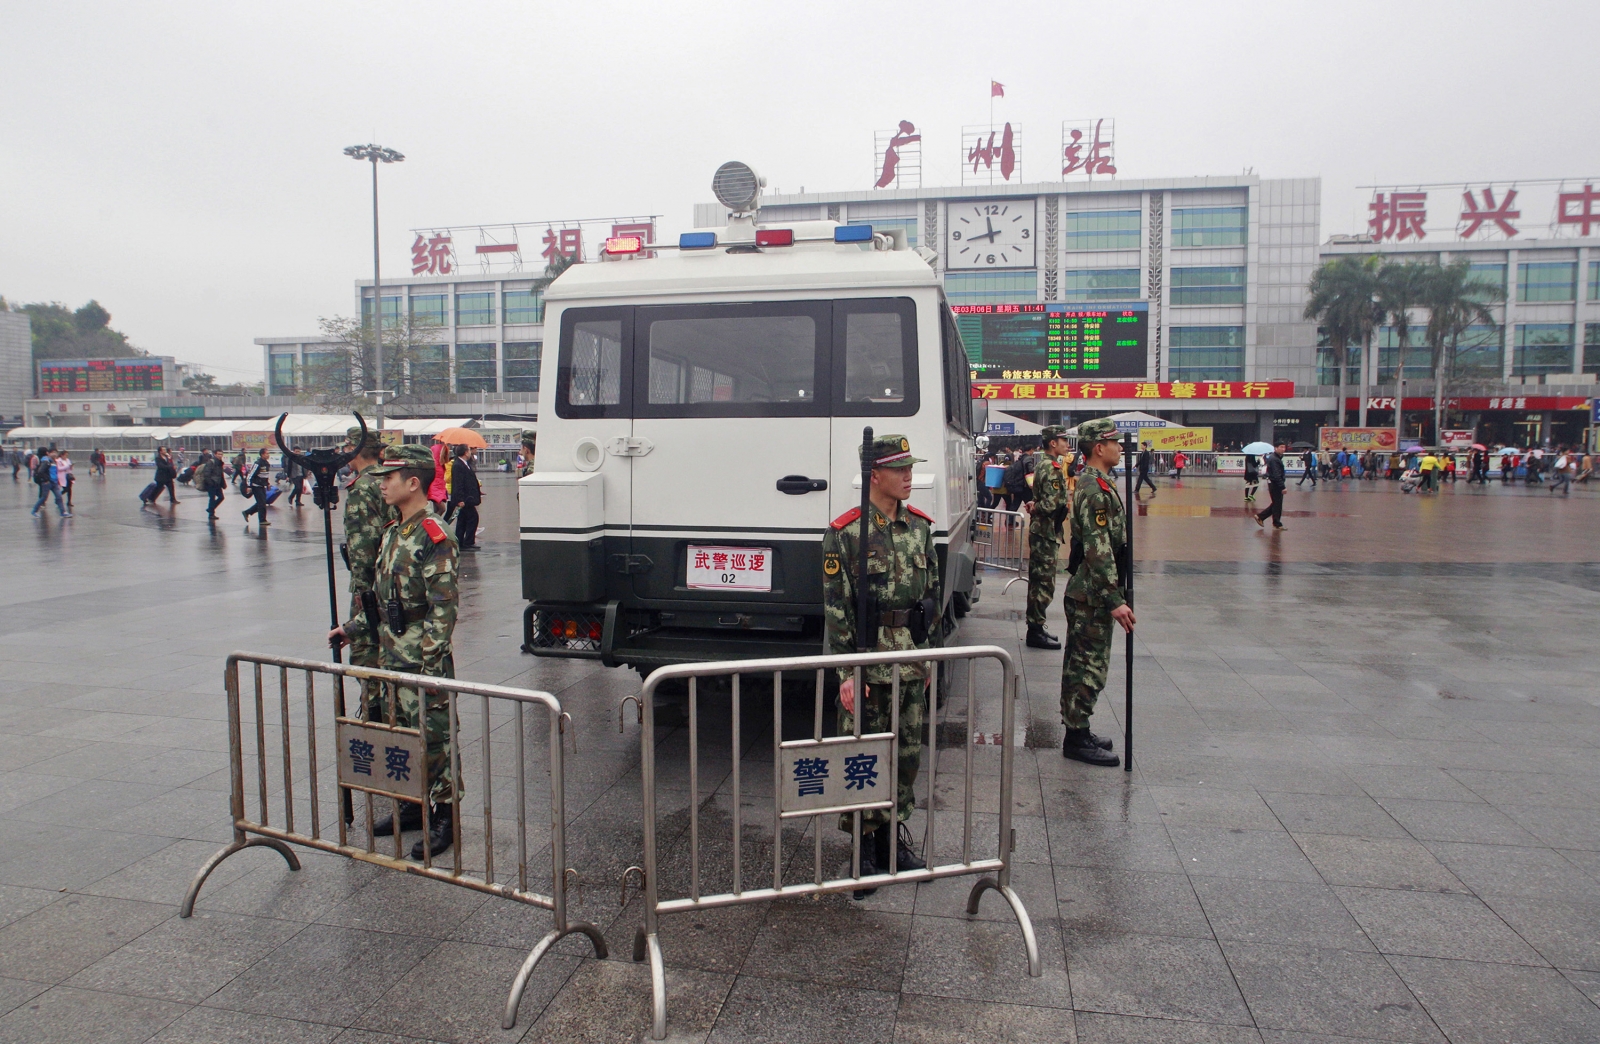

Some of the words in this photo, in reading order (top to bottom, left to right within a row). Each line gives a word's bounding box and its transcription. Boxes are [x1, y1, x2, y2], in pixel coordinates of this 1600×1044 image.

[873, 119, 1116, 188] 广州站
[984, 205, 998, 215] 12
[1368, 184, 1600, 242] 振兴中
[952, 231, 961, 241] 9
[1021, 229, 1030, 239] 3
[986, 254, 995, 264] 6
[996, 305, 1019, 313] 星期五
[1002, 370, 1062, 379] 待旅客如亲人
[979, 383, 1107, 400] 方便出行
[1135, 382, 1270, 399] 温馨出行
[59, 403, 116, 412] 出口处
[1489, 398, 1526, 409] 肯德基
[694, 552, 765, 572] 武警巡逻
[721, 573, 736, 584] 02
[349, 738, 412, 782] 警察
[793, 753, 879, 797] 警察
